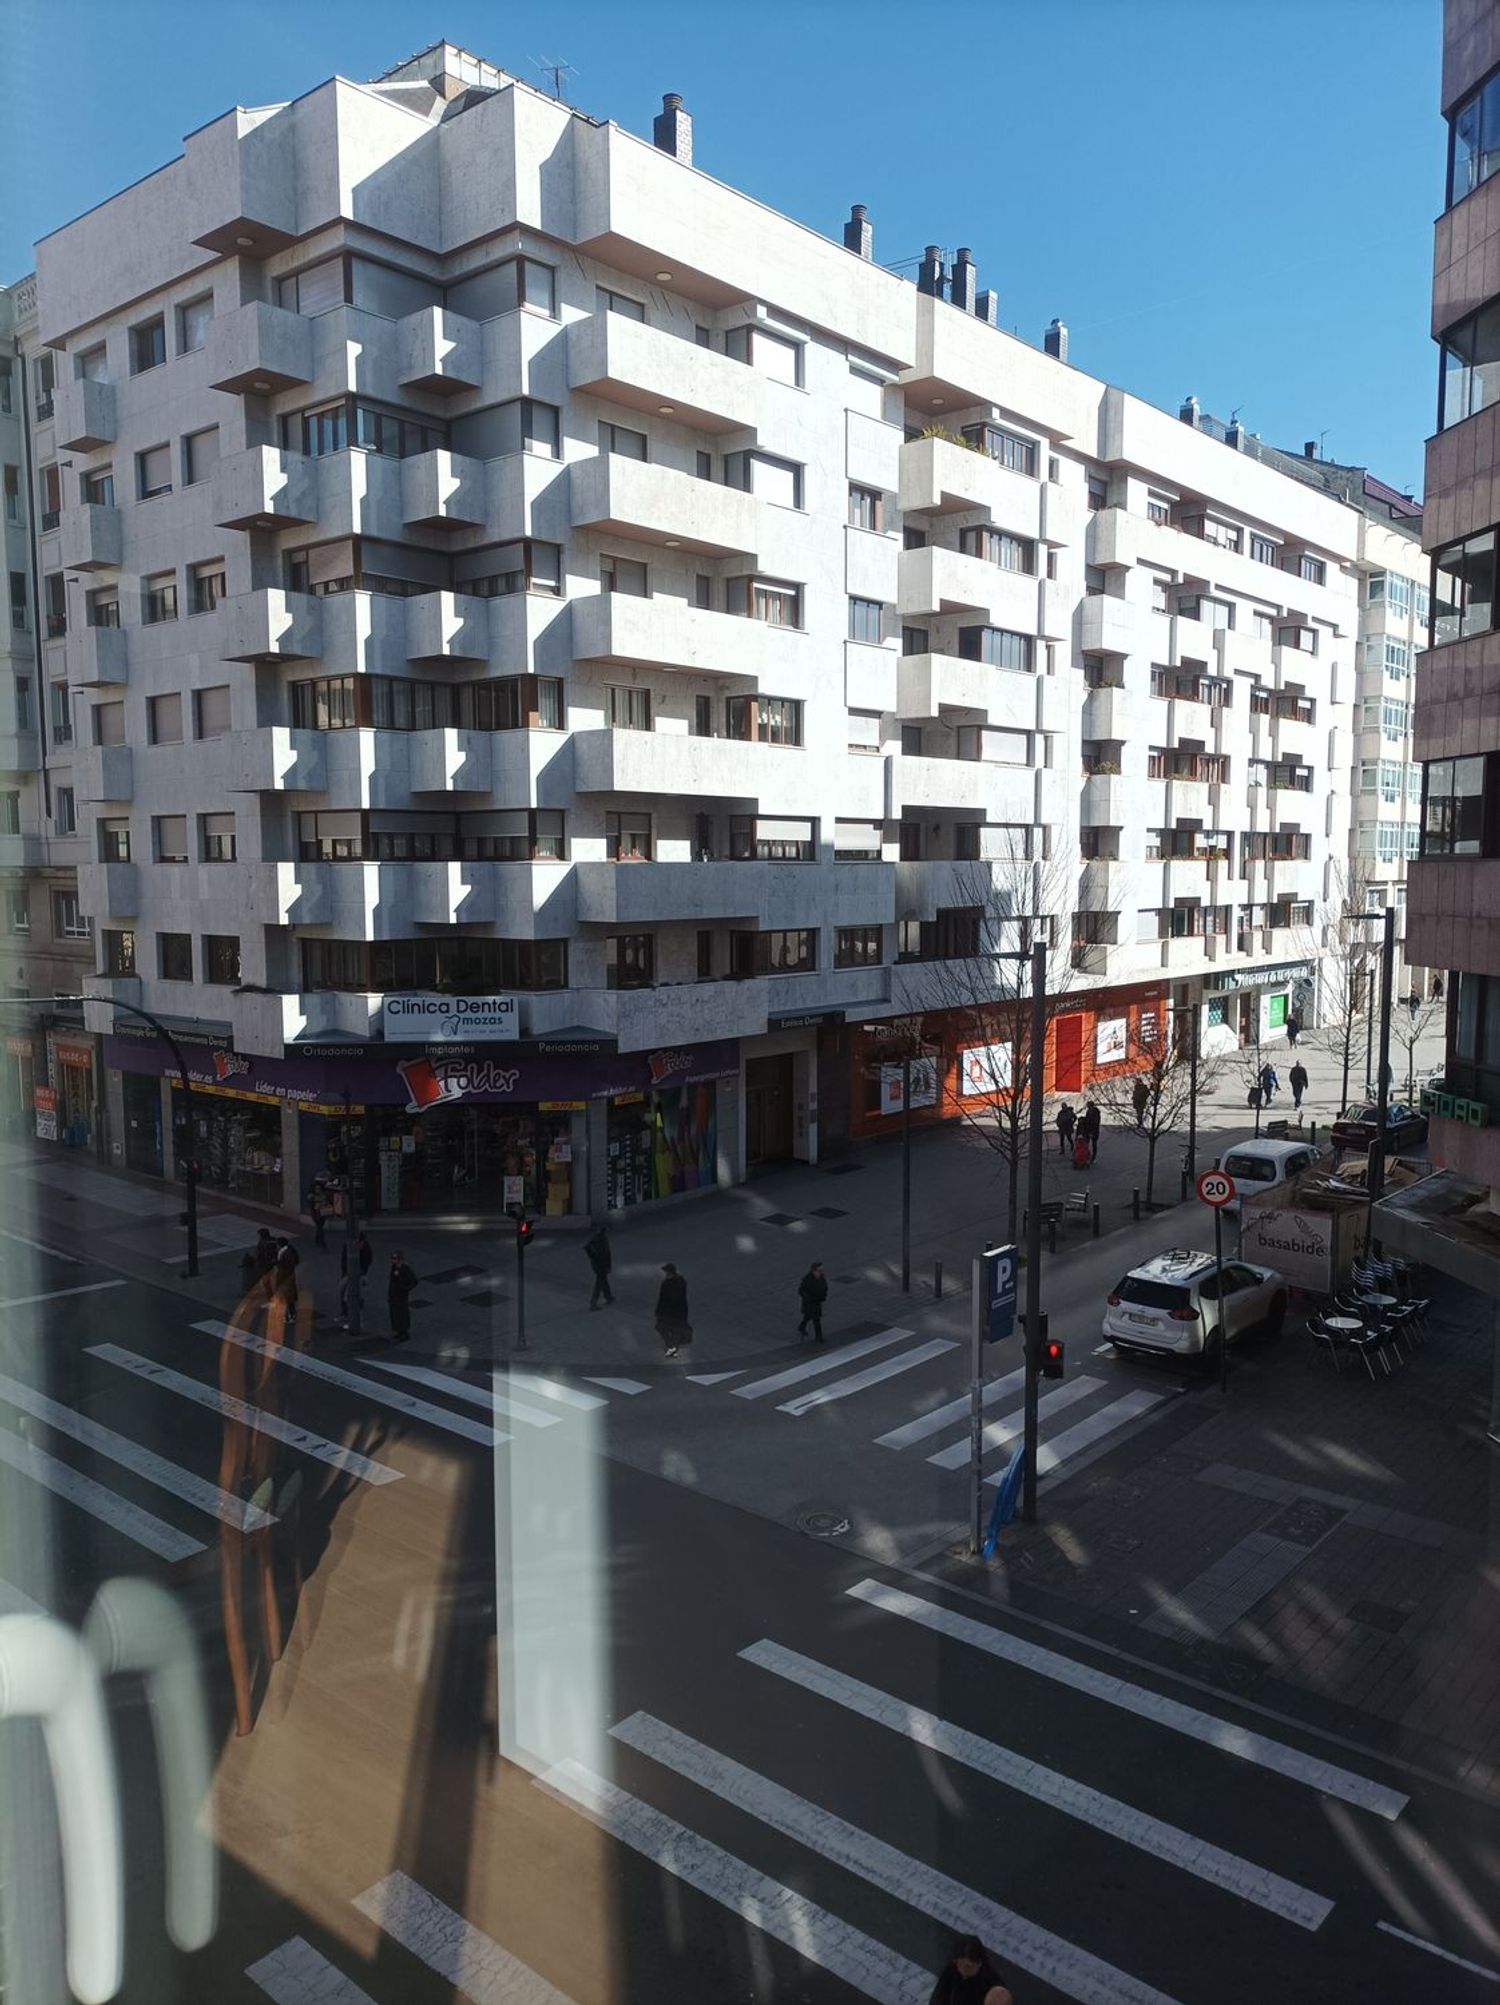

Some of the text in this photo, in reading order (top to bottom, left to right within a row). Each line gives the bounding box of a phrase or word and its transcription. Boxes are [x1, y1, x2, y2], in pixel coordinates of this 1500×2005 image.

[387, 998, 514, 1014] Clínica Dental
[462, 1015, 503, 1025] mozas
[303, 1045, 364, 1056] Ortodoncia
[425, 1044, 475, 1056] Implantes
[538, 1041, 600, 1053] Periodoncia
[434, 1058, 520, 1093] Folder
[1205, 1181, 1226, 1196] 20
[996, 1257, 1012, 1294] P
